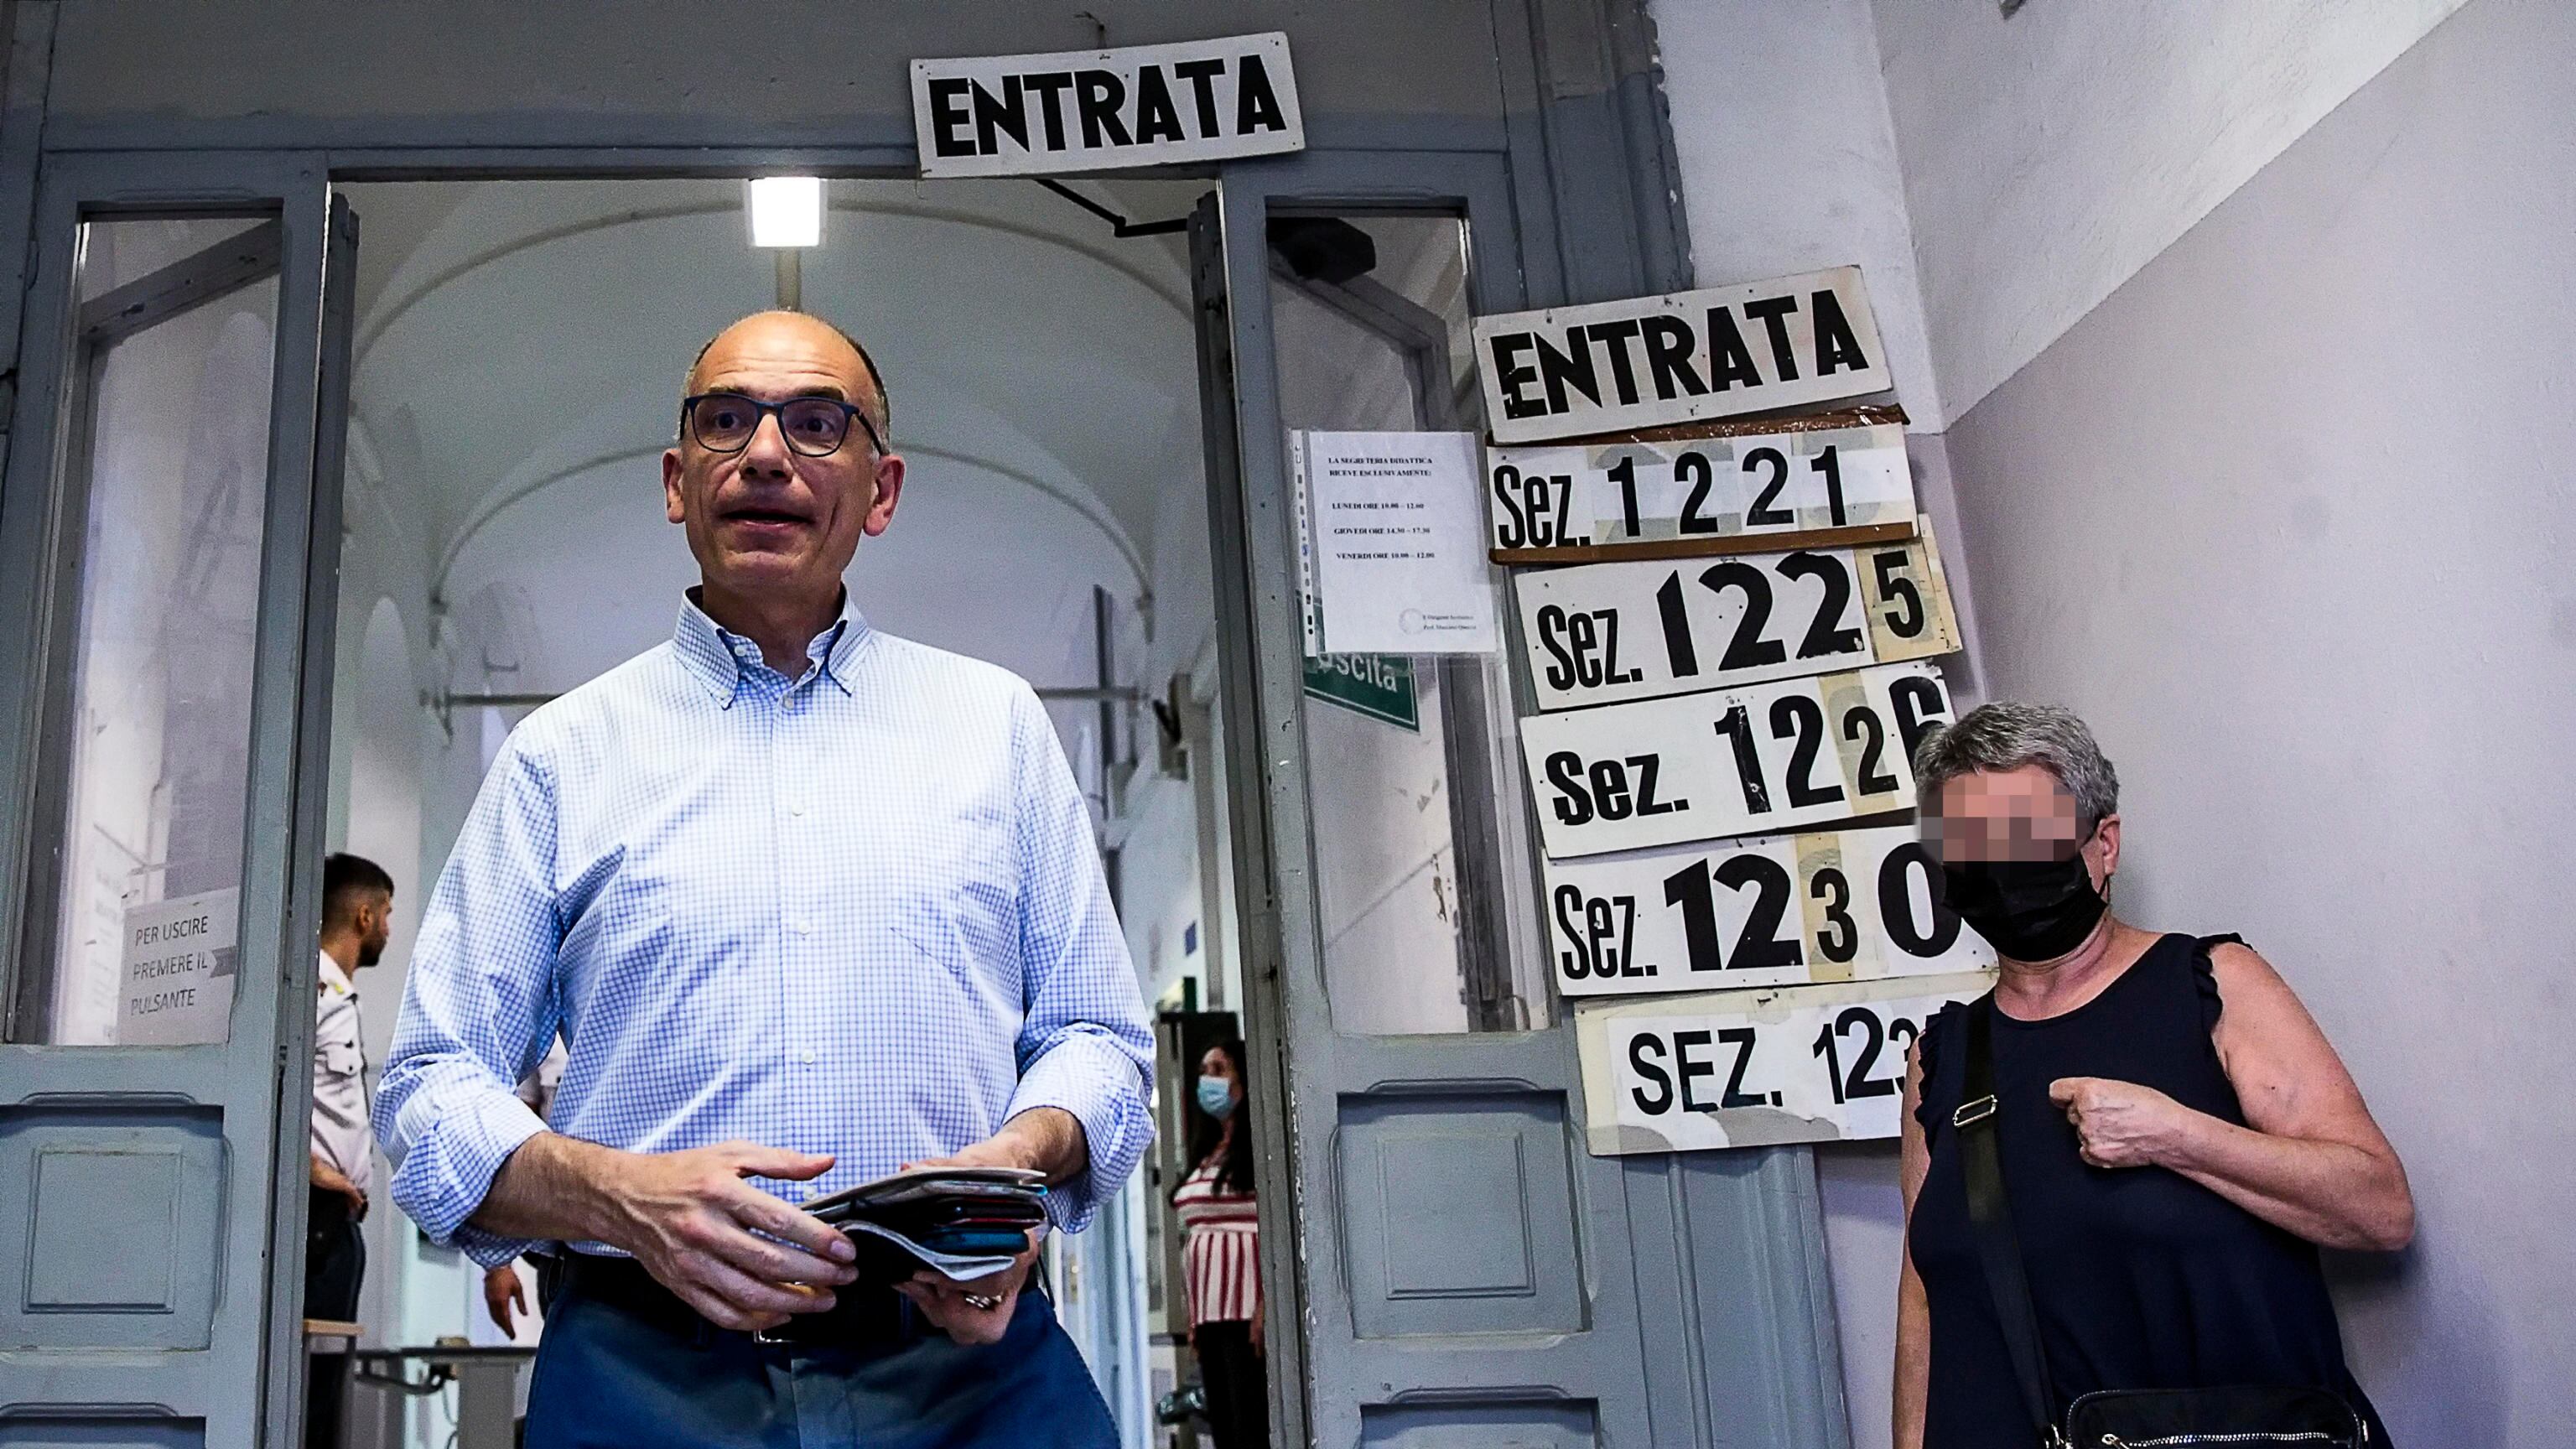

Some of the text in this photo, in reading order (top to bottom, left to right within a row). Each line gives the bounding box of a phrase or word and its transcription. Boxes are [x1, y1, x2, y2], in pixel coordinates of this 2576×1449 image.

[928, 55, 1287, 158] ENTRATA
[1489, 289, 1869, 420] ENTRATA
[1493, 445, 1846, 548] Sez. 1221
[1537, 550, 1924, 691] Sez. 1225
[1545, 676, 1945, 826] Sez. 1226
[135, 916, 209, 947] PER USCIRE
[1554, 842, 1962, 979] Sez. 1230
[131, 988, 196, 1015] PULSANTE
[133, 952, 208, 980] PREMERE IL
[1629, 1027, 1783, 1116] SEZ.
